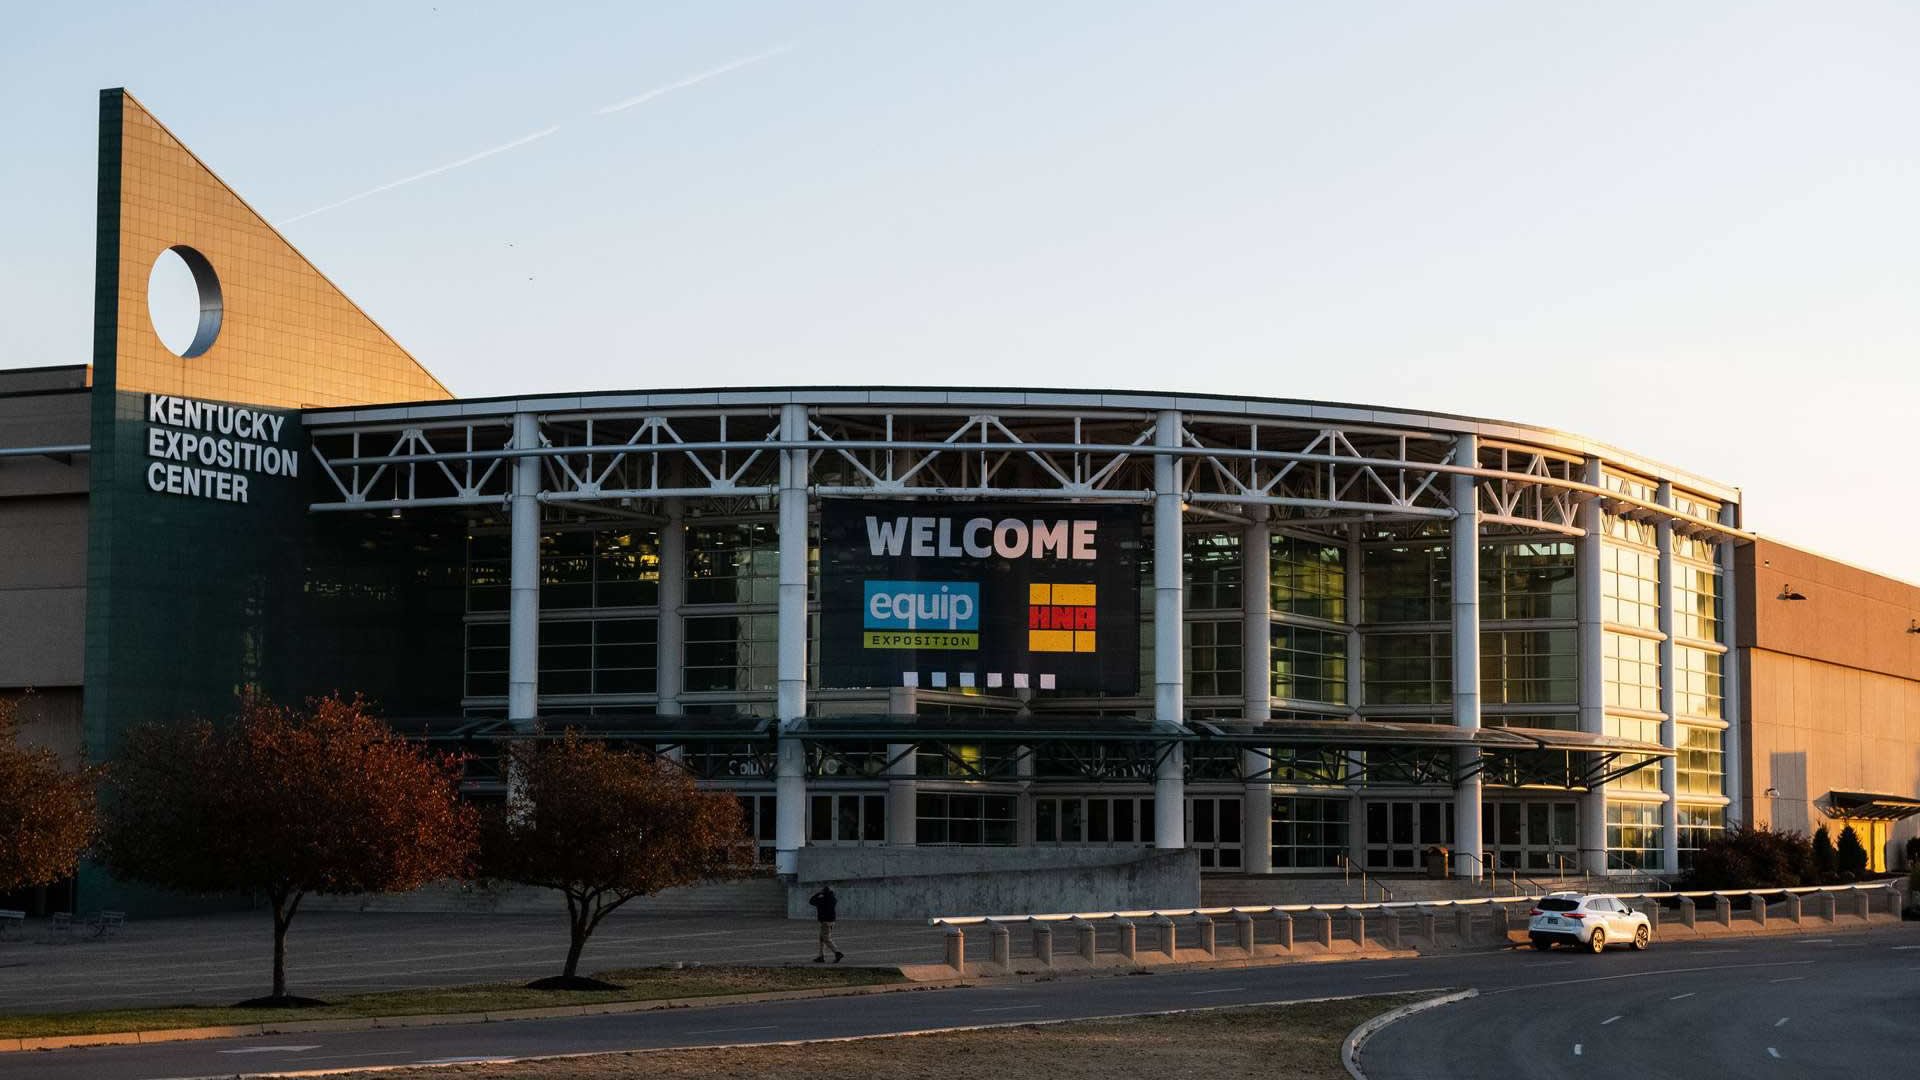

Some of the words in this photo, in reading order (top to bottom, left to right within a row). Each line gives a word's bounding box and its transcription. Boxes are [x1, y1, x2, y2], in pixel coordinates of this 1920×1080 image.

[150, 393, 285, 442] KENTUCKY
[149, 428, 298, 477] EXPOSITION
[148, 462, 248, 503] CENTER
[865, 516, 1098, 560] WELCOME
[870, 585, 974, 629] equip
[1029, 606, 1096, 630] HNA
[872, 635, 971, 646] EXPOSITION
